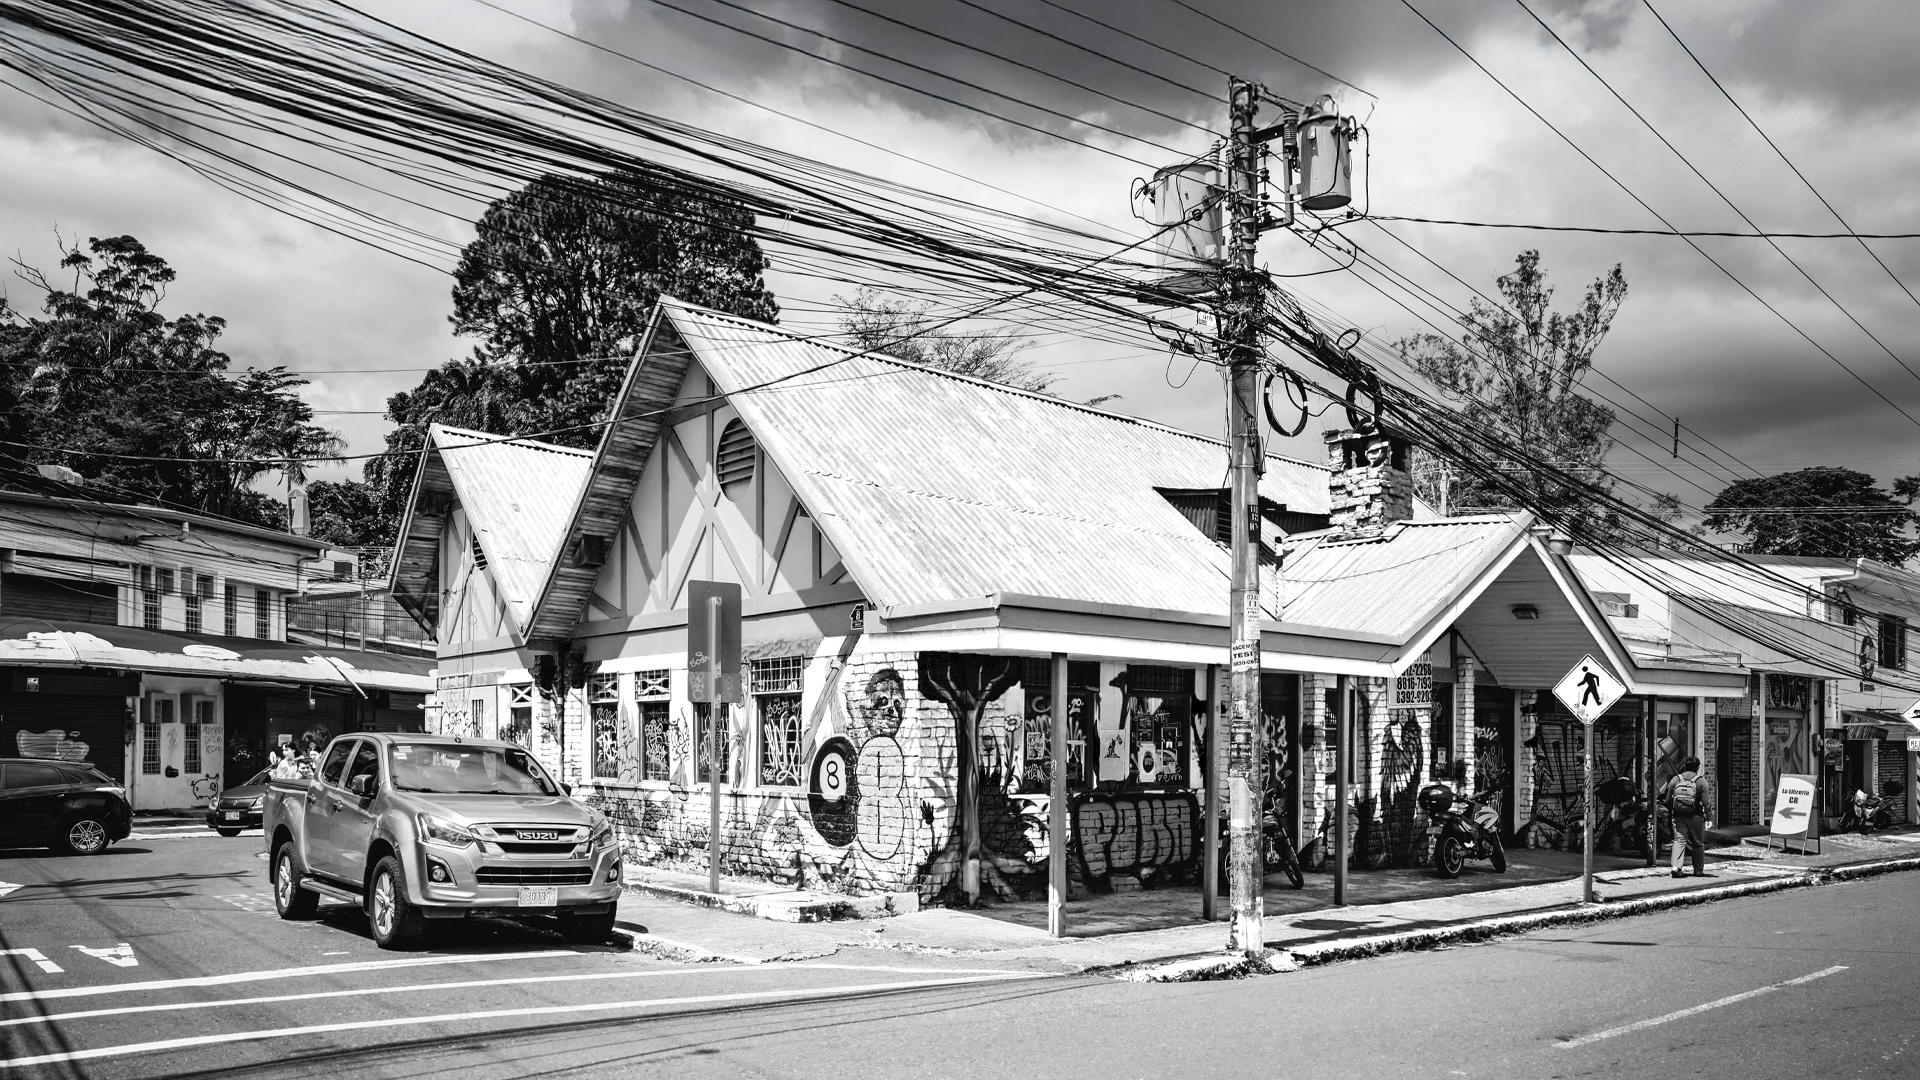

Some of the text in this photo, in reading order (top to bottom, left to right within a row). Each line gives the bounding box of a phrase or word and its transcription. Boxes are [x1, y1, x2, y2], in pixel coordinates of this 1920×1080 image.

[1397, 676, 1432, 690] 8816-7193
[1788, 796, 1799, 804] CR
[519, 831, 558, 840] ISUZU
